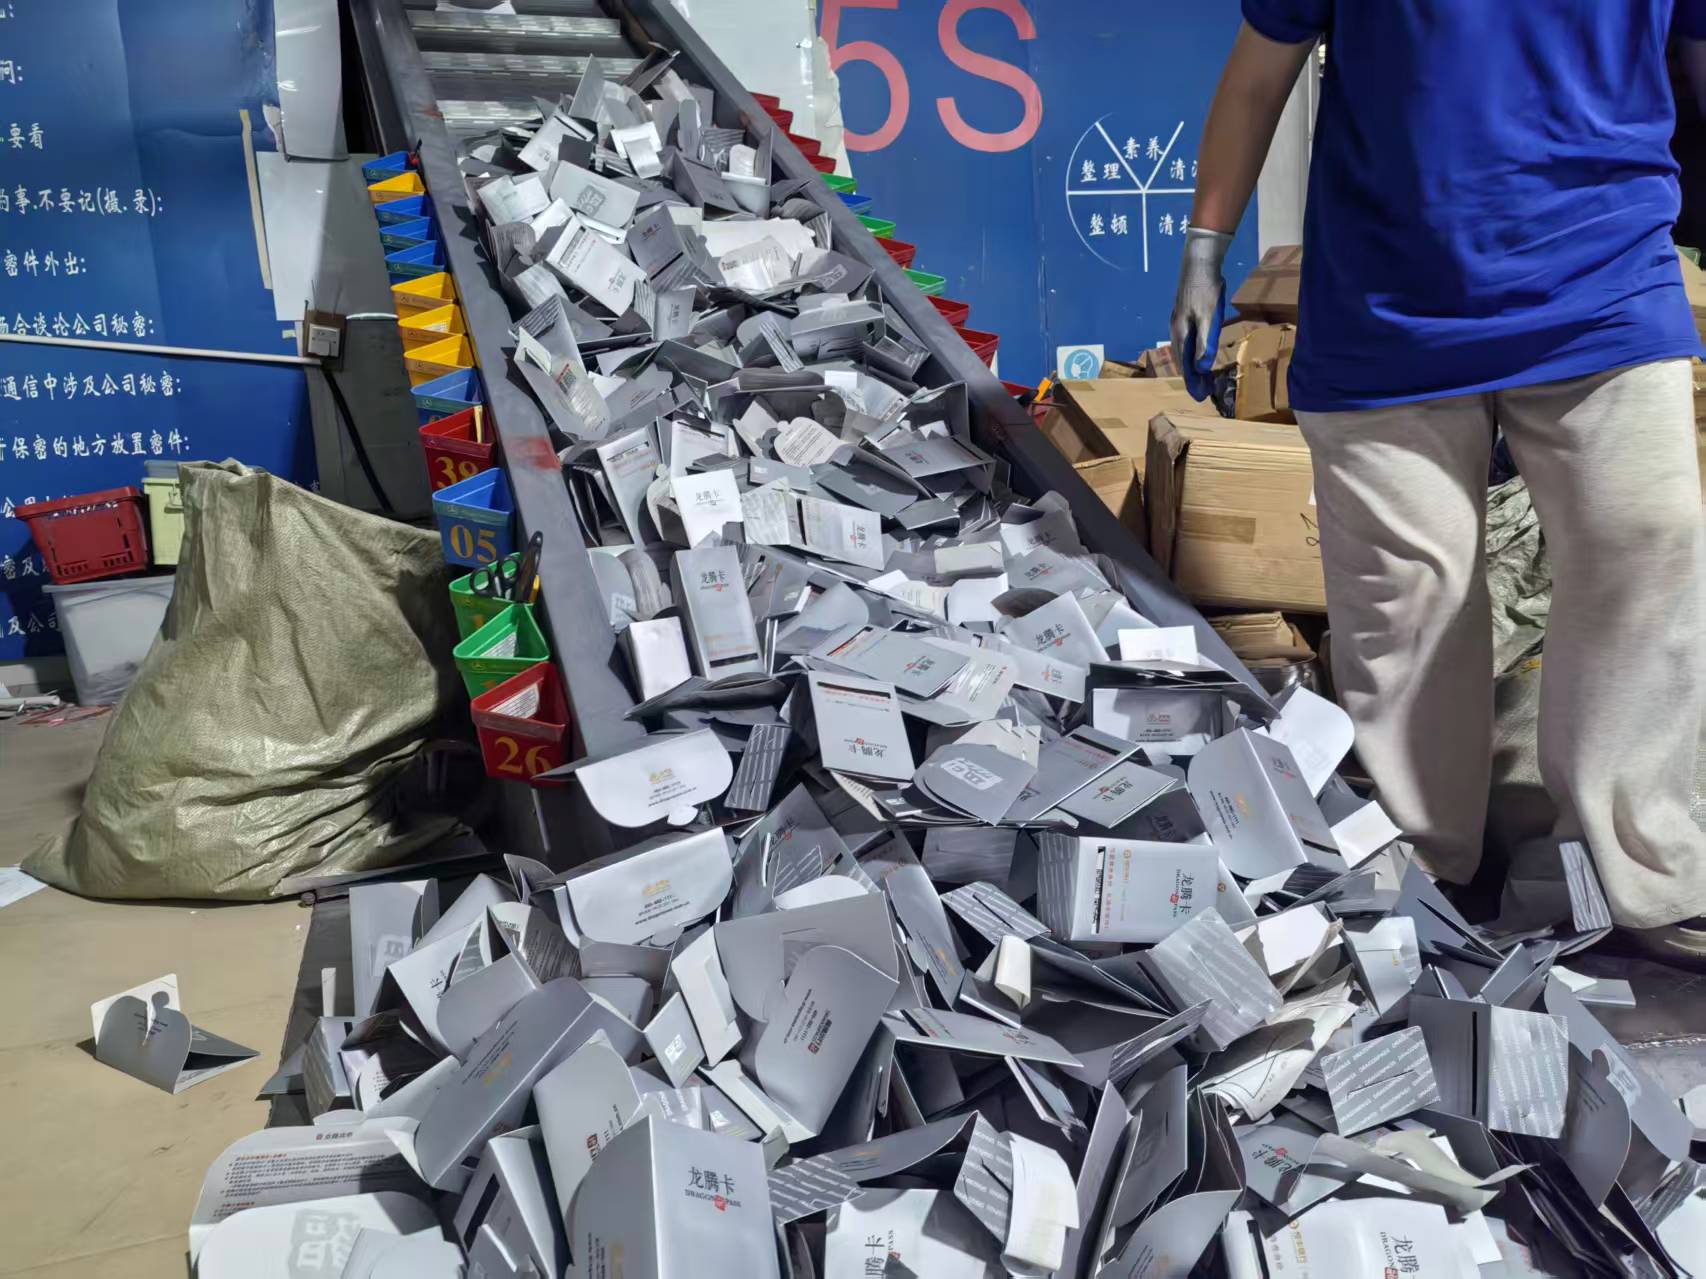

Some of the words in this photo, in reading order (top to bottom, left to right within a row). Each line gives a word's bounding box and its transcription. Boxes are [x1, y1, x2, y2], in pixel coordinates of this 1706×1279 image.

[819, 0, 1043, 152] 5S
[0, 122, 44, 150] 要看
[1122, 136, 1165, 160] 素养
[1080, 160, 1121, 182] 整理
[1089, 213, 1128, 236] 整顿
[450, 524, 497, 562] 05
[0, 612, 61, 638] 及公司
[495, 735, 550, 776] 26
[688, 1166, 736, 1196] 龙腾卡
[1379, 1232, 1396, 1268] DRAGON
[1392, 1234, 1420, 1279] 龙腾
